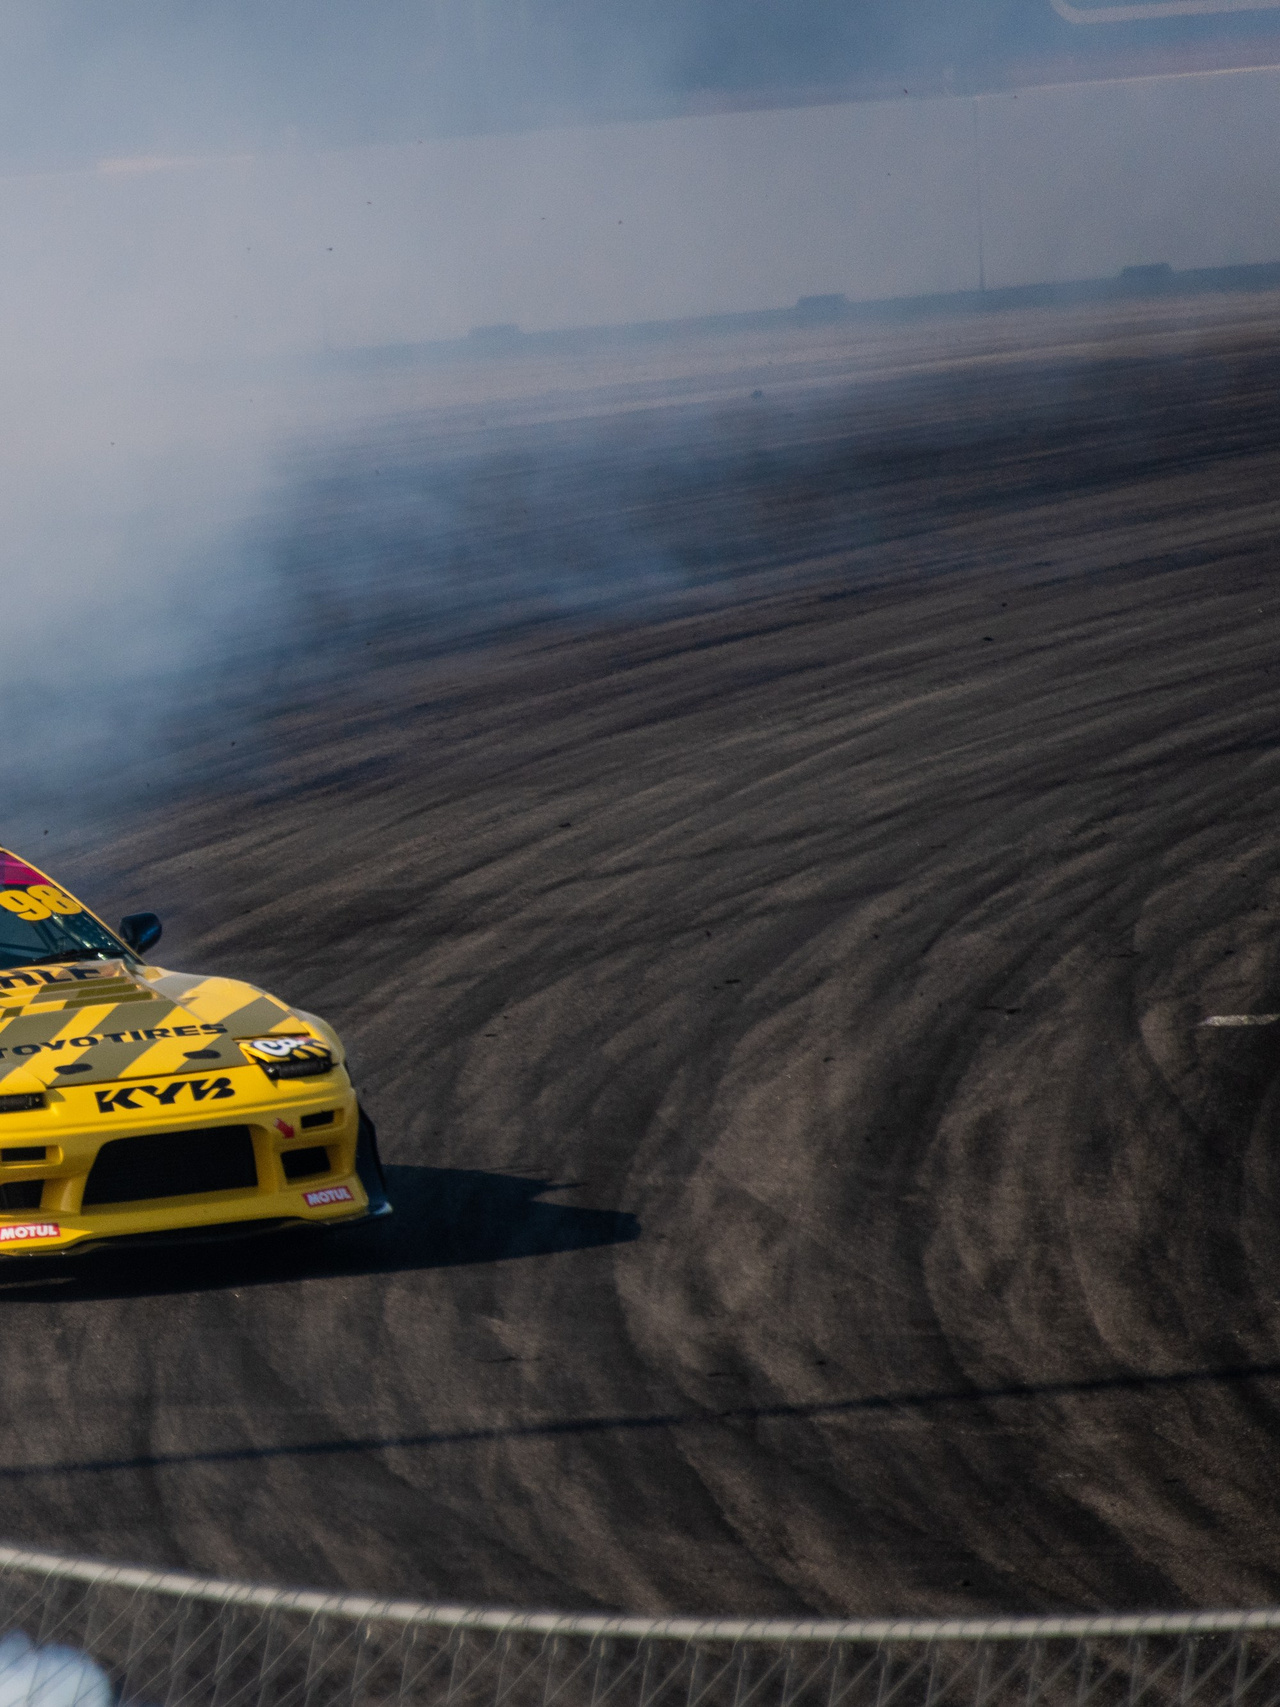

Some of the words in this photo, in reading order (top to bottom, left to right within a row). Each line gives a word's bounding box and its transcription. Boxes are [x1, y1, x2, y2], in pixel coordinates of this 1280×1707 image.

[102, 1023, 228, 1043] TIRES
[94, 1077, 236, 1114] KYB
[305, 1187, 352, 1206] MOTUL
[0, 1224, 58, 1241] MOTUL
